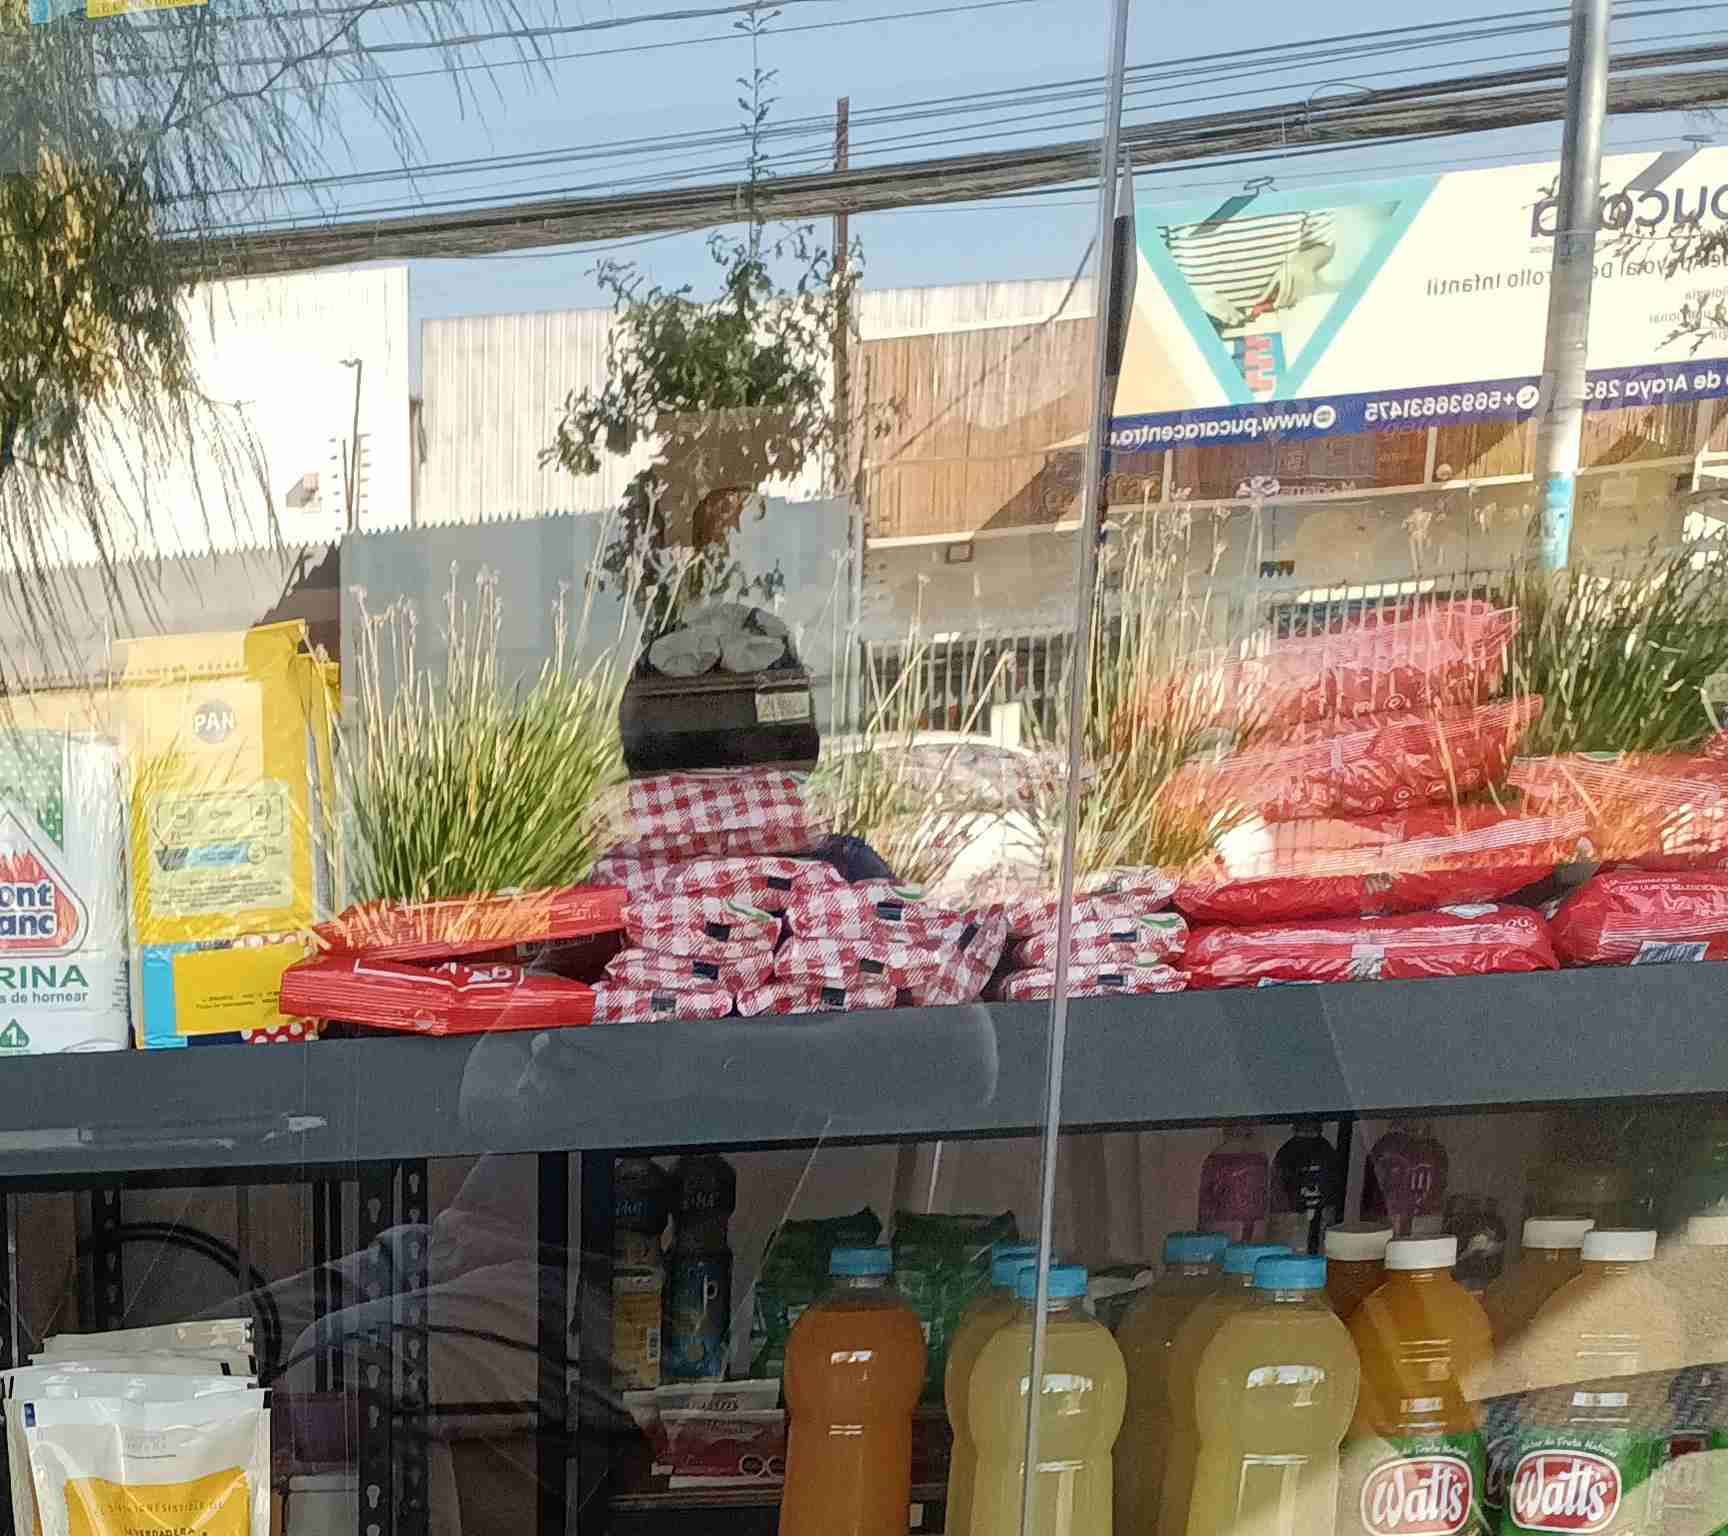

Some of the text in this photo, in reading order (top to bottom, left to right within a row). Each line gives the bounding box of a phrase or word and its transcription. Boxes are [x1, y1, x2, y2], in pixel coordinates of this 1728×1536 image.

[11, 992, 28, 1003] de
[32, 991, 88, 1003] hornear
[1517, 1456, 1608, 1522] Watt's
